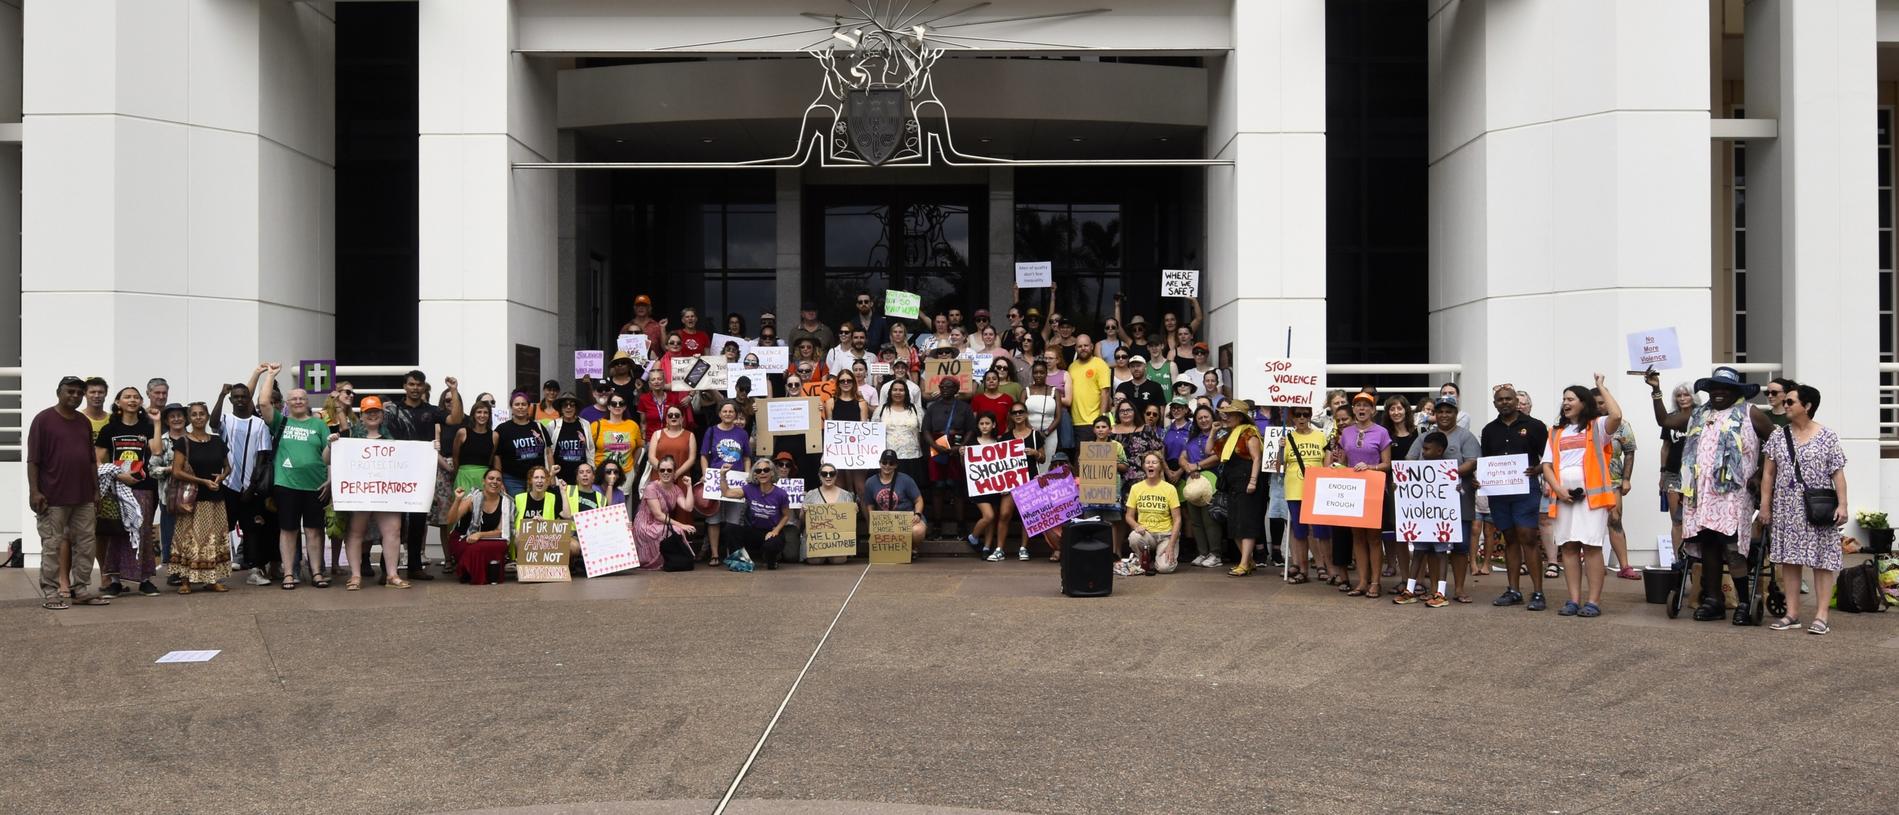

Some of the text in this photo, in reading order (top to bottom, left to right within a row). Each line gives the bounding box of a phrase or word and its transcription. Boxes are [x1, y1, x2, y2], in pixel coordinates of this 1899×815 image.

[1165, 271, 1193, 280] WHERE
[1640, 354, 1666, 363] Violence
[937, 359, 961, 376] NO
[1265, 361, 1292, 372] STOP
[1273, 374, 1317, 385] VIOLENCE
[1268, 385, 1280, 393] TO
[1271, 391, 1312, 404] WOMEN!
[826, 422, 880, 436] PLEASE
[513, 437, 536, 448] VOTE
[834, 434, 866, 444] STOP
[362, 446, 395, 459] STOP
[825, 444, 879, 456] KILLING
[967, 439, 1024, 462] LOVE
[1087, 445, 1112, 458] STOP
[844, 455, 865, 467] US
[1082, 464, 1113, 480] KILLING
[1409, 465, 1436, 483] NO
[975, 468, 1029, 494] HURT
[1328, 483, 1357, 491] ENOUGH
[1051, 484, 1076, 500] JULY
[1399, 484, 1449, 499] MORE
[1138, 494, 1166, 502] JUSTINE
[1326, 500, 1355, 508] ENOUGH
[808, 504, 837, 516] BOYS
[836, 512, 847, 520] BE
[1041, 500, 1074, 520] DOMESTIC
[1401, 501, 1458, 521] violence
[523, 522, 568, 534] IF UR NOT
[1027, 514, 1062, 535] TERROR
[810, 532, 840, 540] HELD
[875, 534, 906, 544] BEAR
[809, 539, 856, 552] ACCOUNTABLE
[872, 543, 908, 552] EITHER
[526, 552, 564, 563] UR NOT
